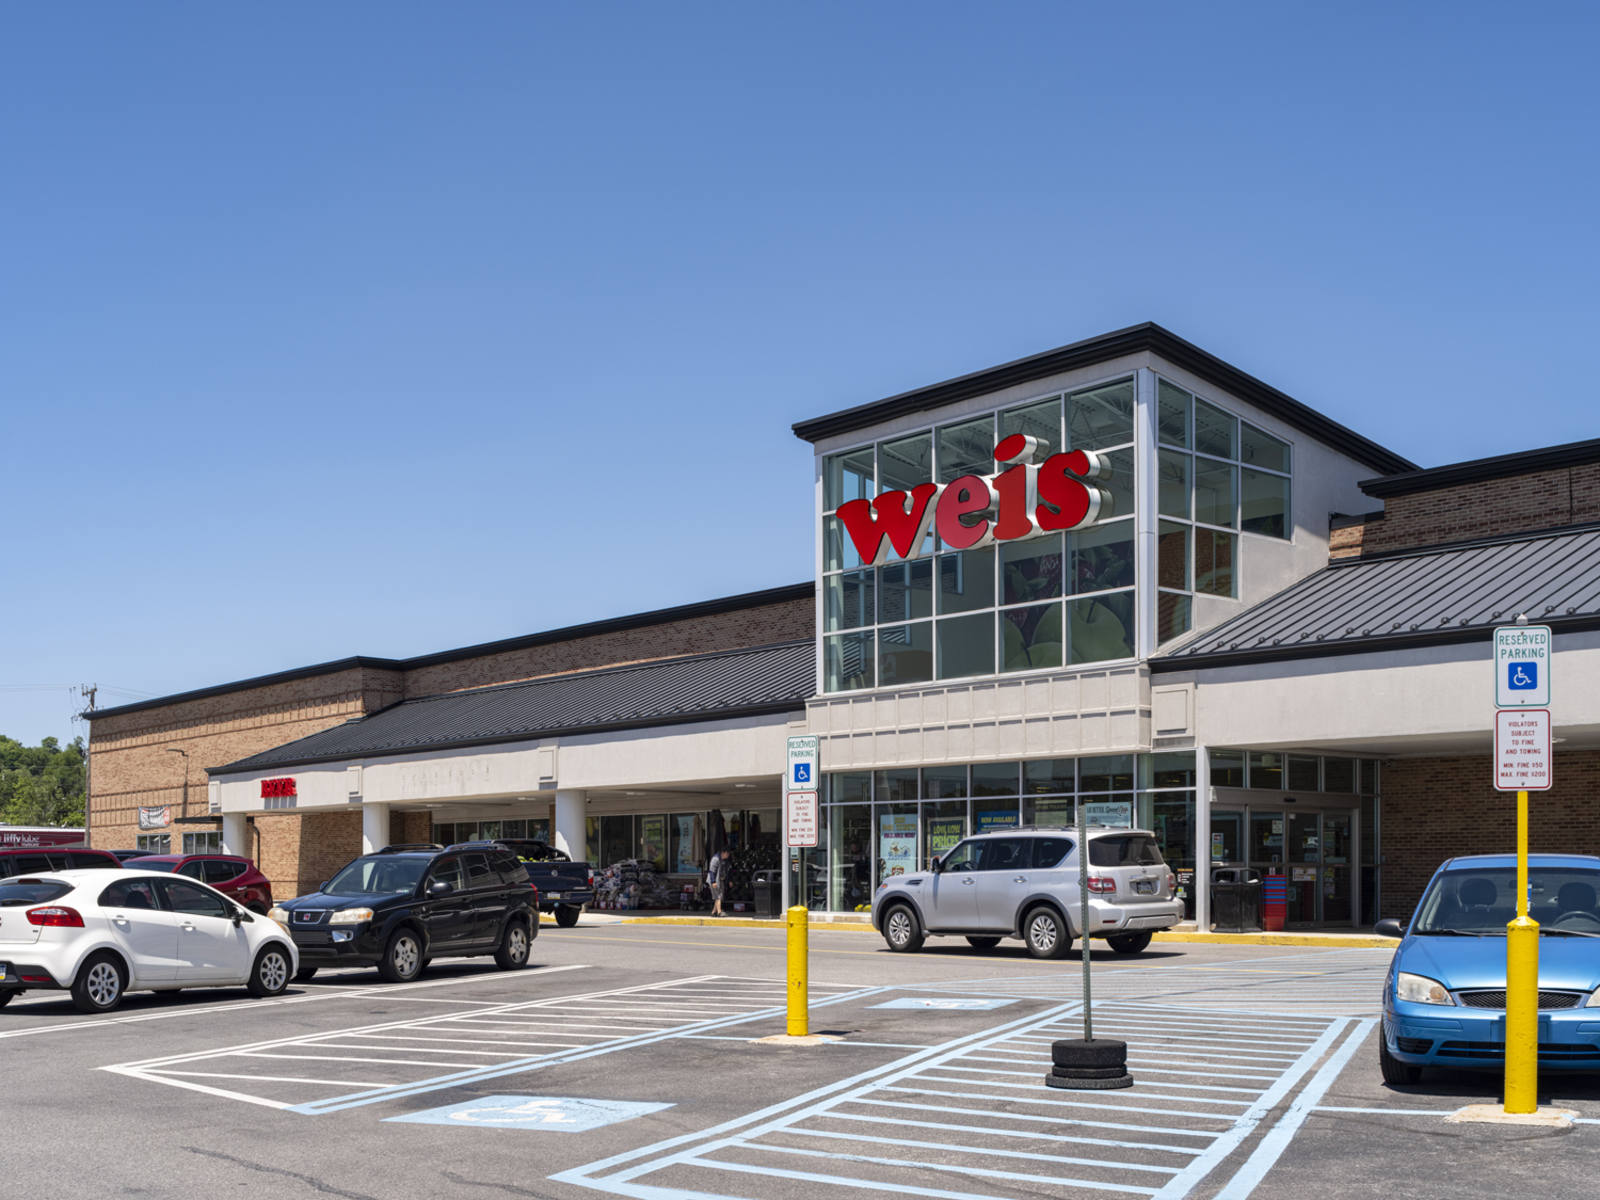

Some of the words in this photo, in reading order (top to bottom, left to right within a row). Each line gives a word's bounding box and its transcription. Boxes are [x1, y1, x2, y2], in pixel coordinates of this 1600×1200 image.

[836, 433, 1095, 565] weis
[1499, 633, 1546, 645] RESERVED
[1501, 647, 1545, 659] PARKING
[933, 835, 960, 848] PRICES
